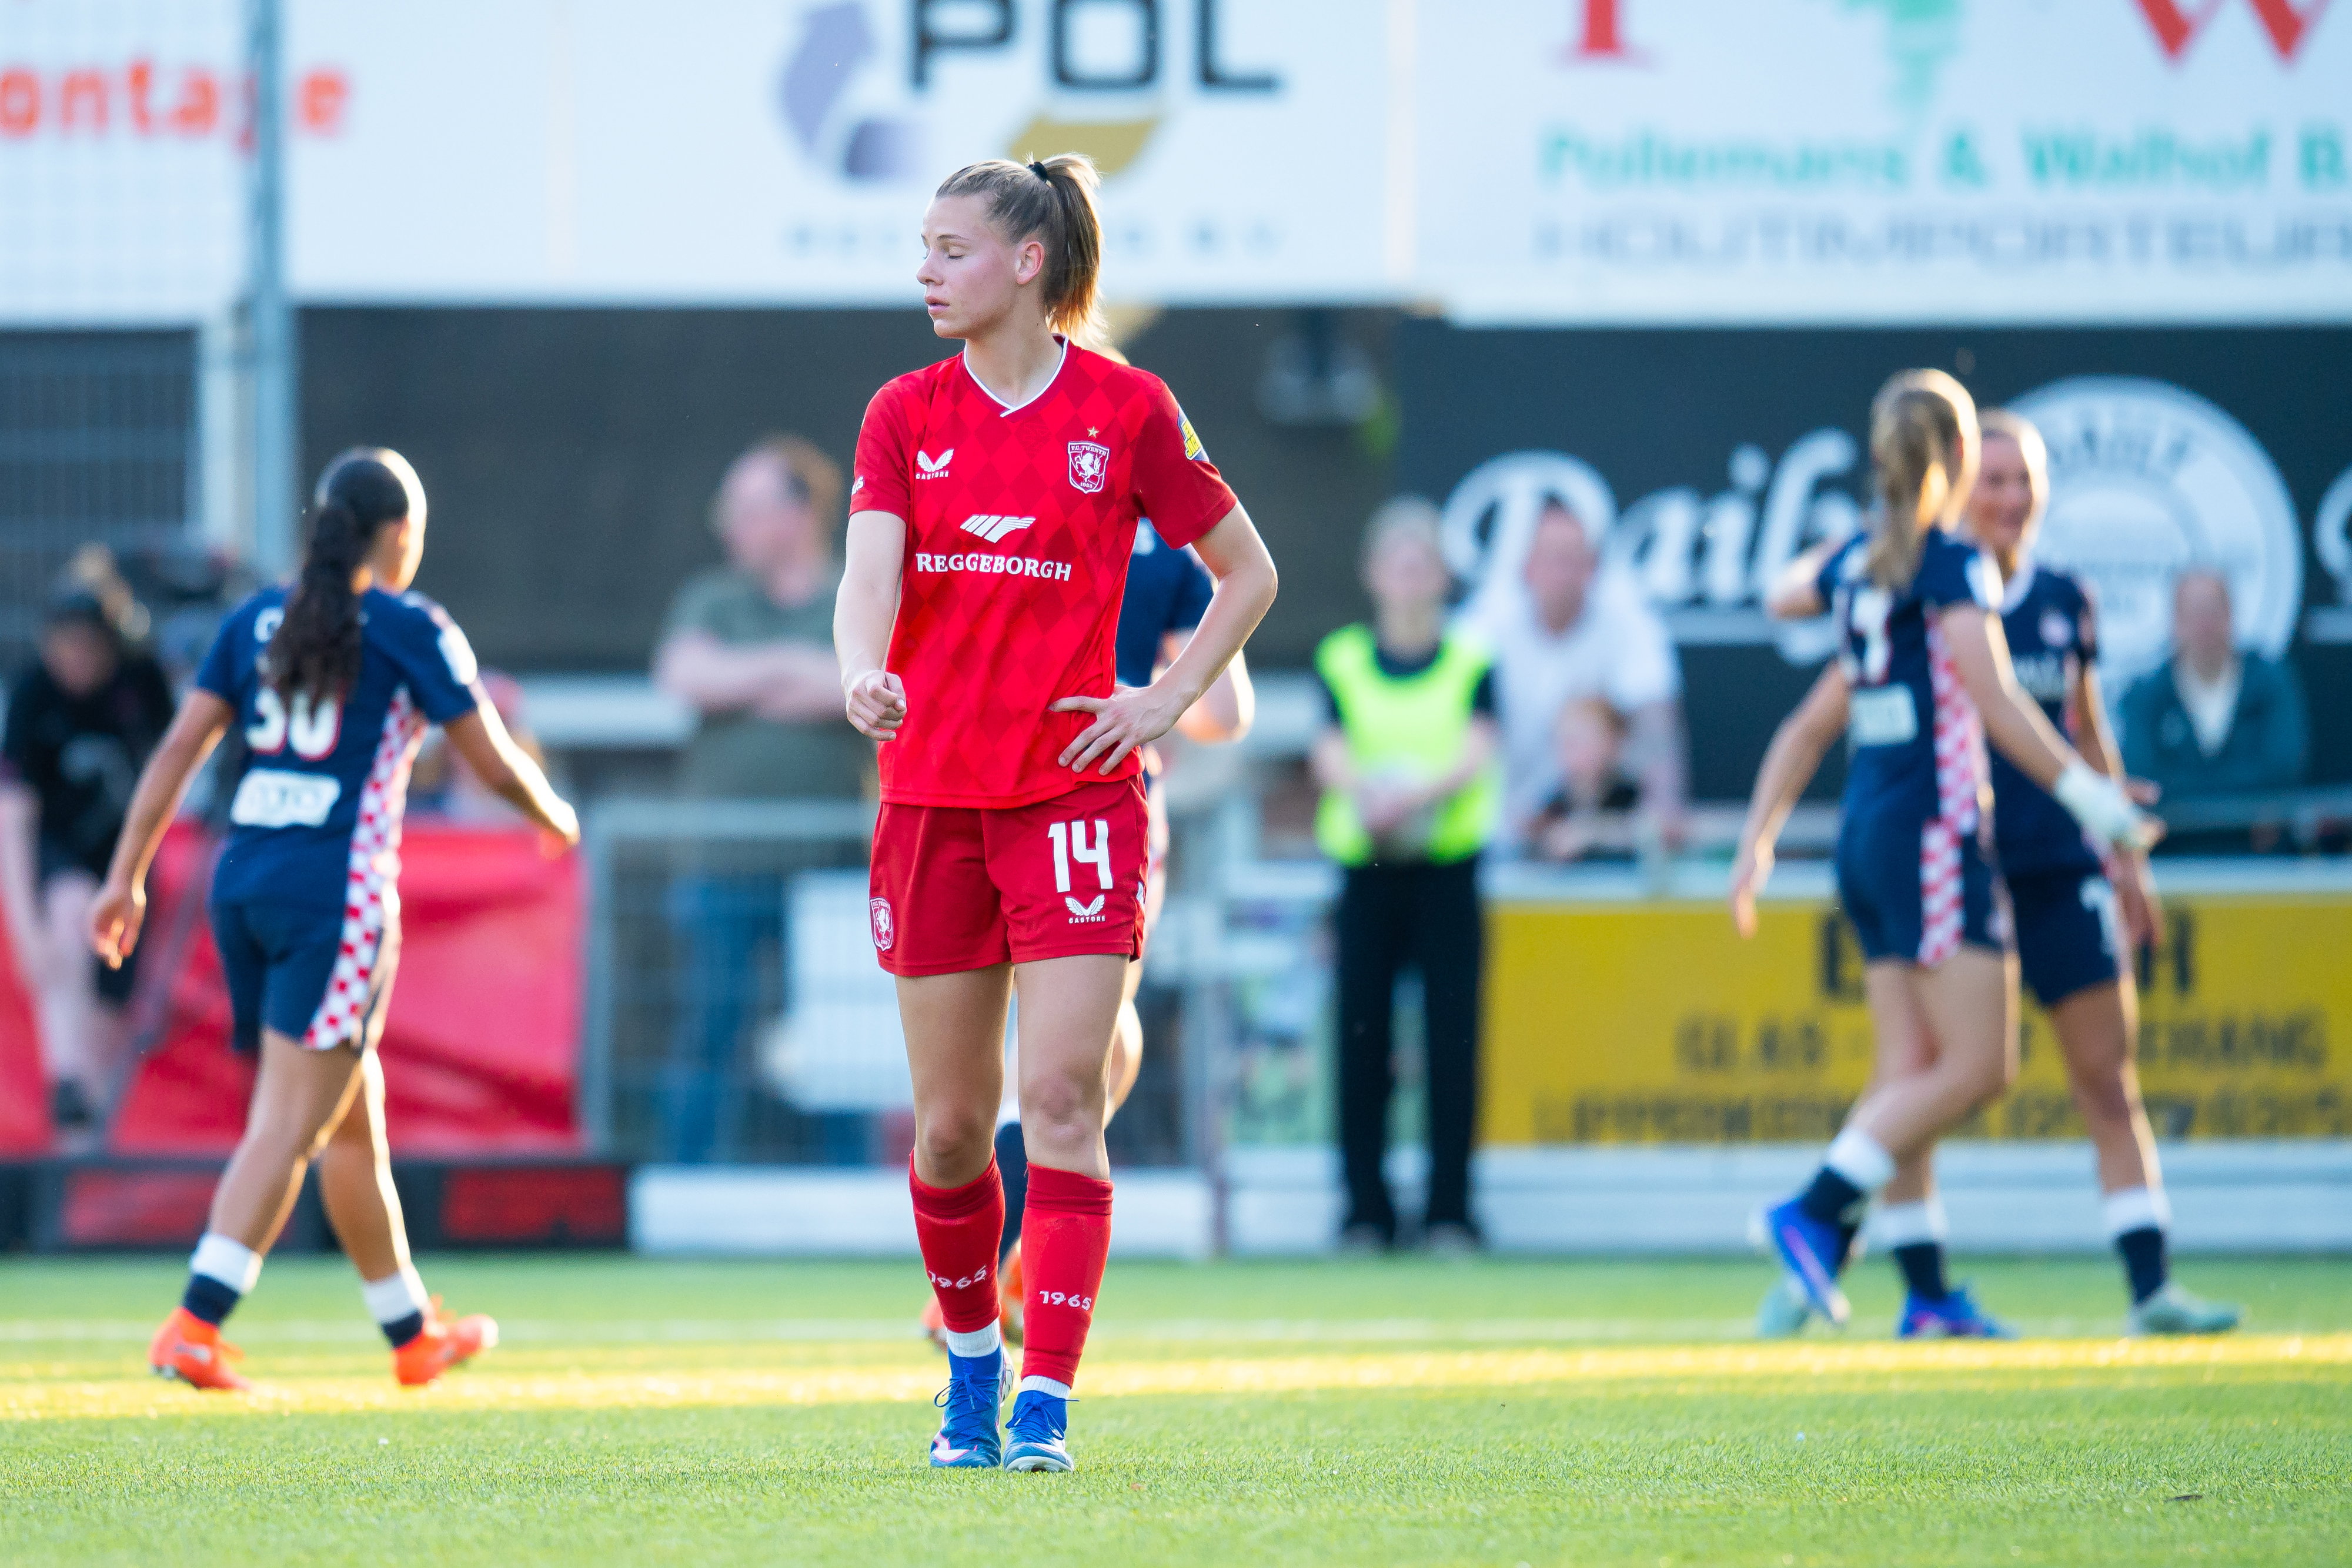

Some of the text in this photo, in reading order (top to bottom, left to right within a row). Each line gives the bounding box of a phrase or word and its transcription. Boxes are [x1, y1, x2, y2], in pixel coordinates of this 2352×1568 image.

[908, 0, 1283, 91] POL
[916, 553, 1071, 581] REGGEBORGH
[1047, 819, 1114, 894] 14
[928, 1265, 987, 1289] 1965
[1039, 1290, 1092, 1311] 1965
